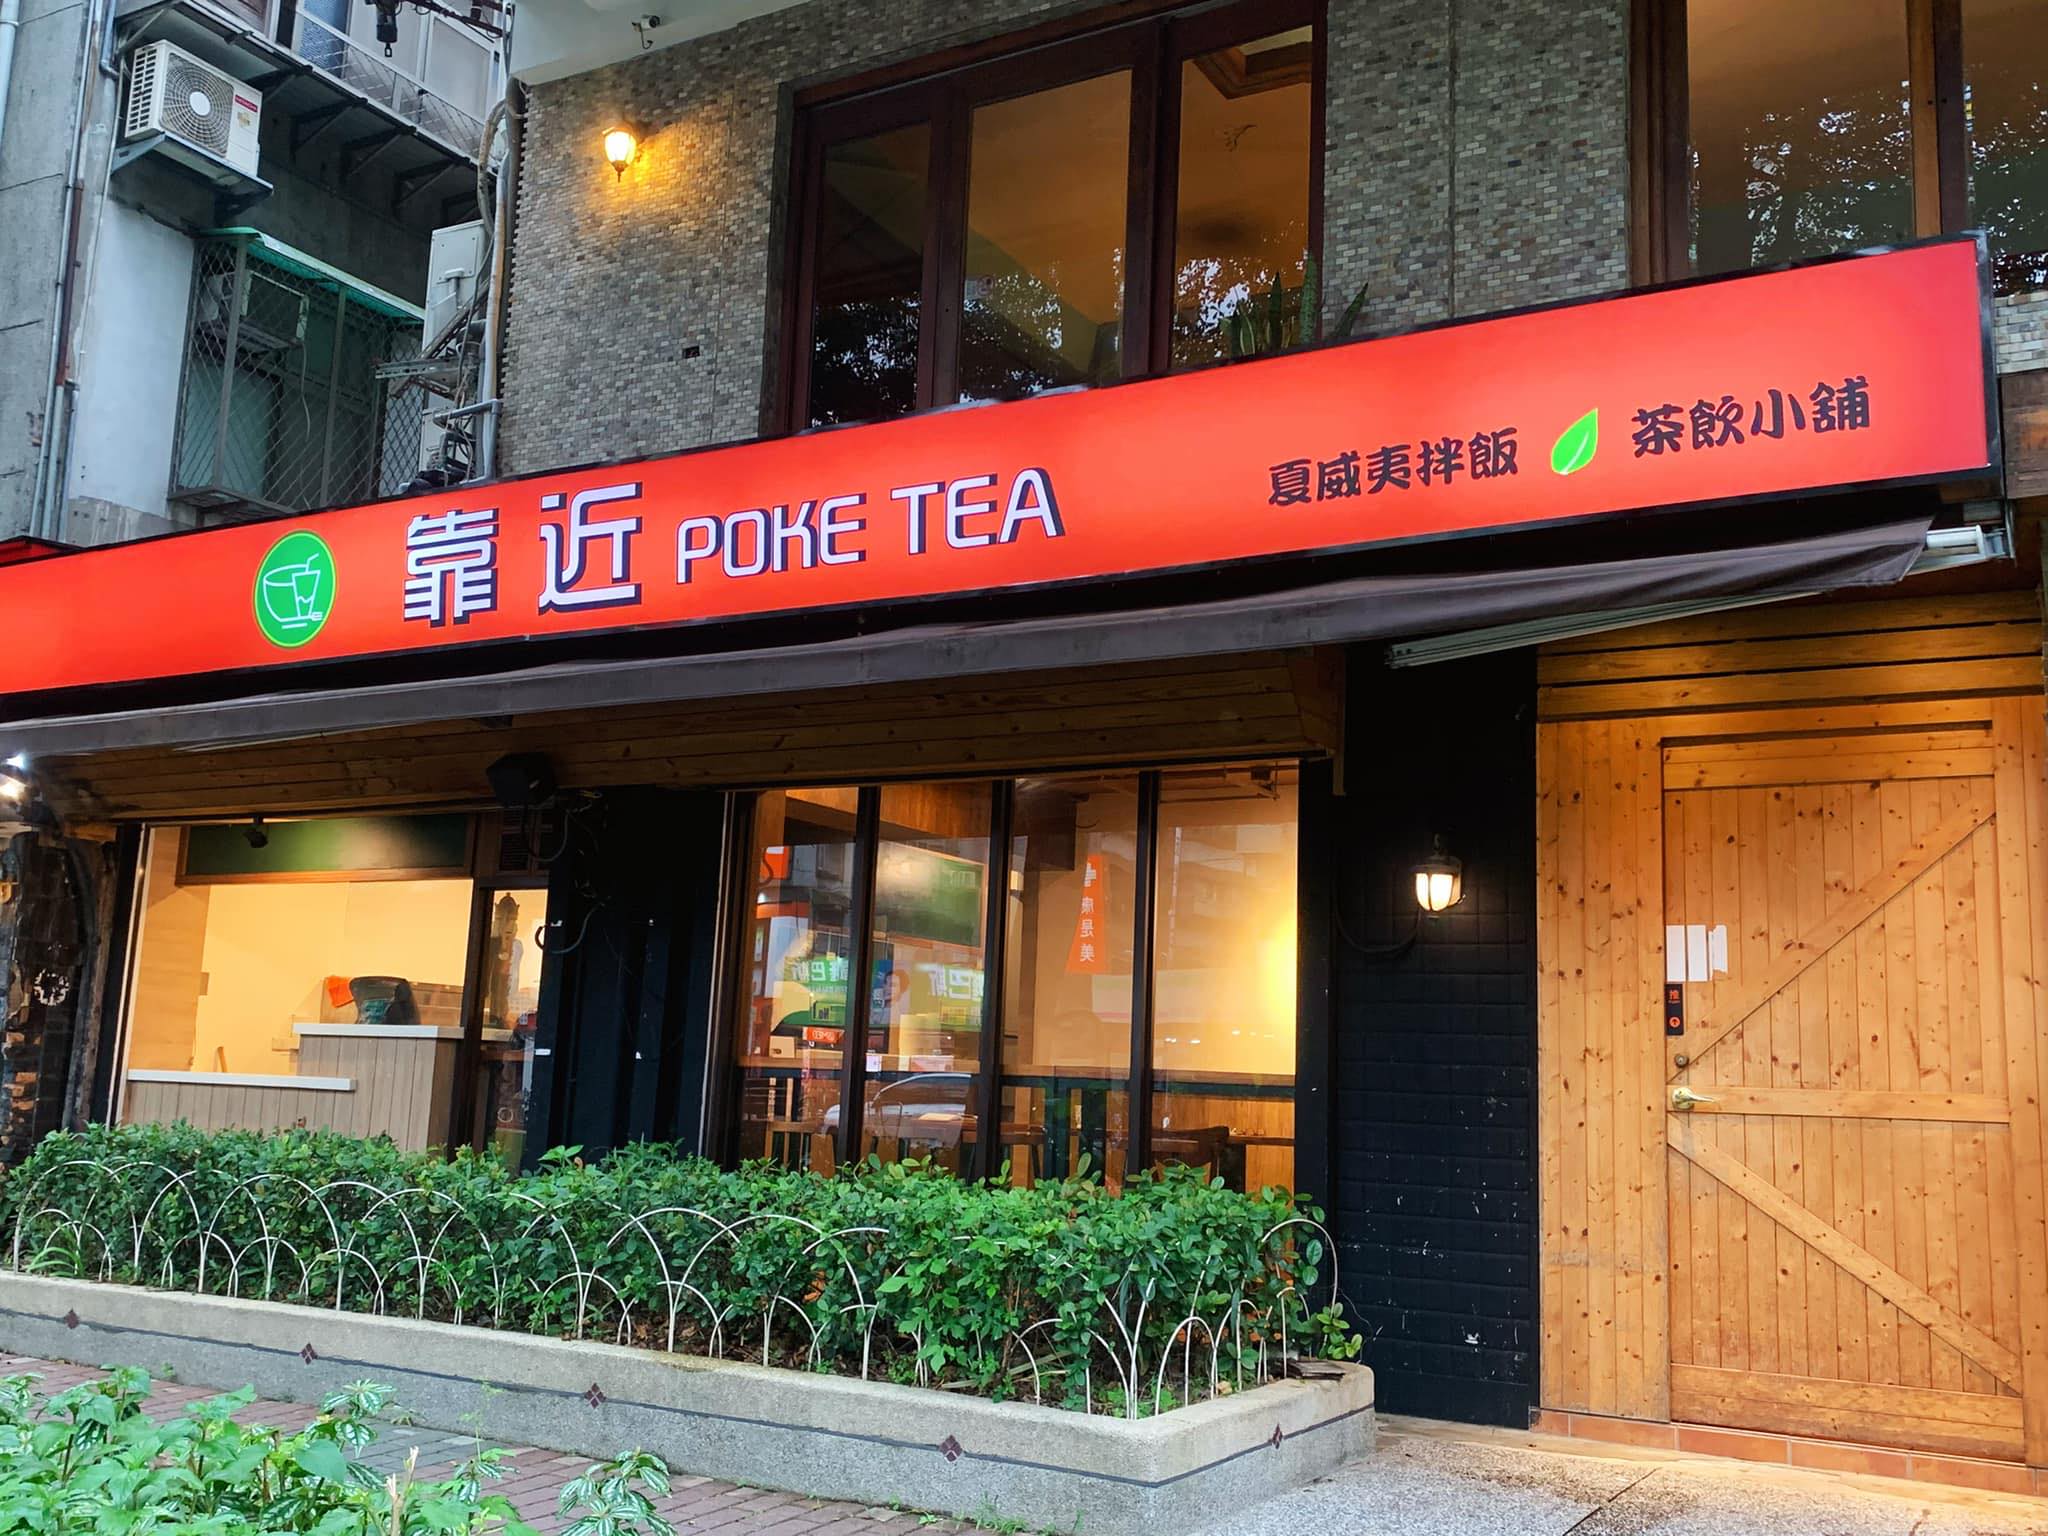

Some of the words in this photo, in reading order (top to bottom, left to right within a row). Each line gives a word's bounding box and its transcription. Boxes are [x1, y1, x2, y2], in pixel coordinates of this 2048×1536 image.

[1632, 376, 1870, 458] 茶飲小舖
[1269, 428, 1518, 506] 夏威夷拌飯
[404, 482, 642, 627] 靠近
[676, 493, 867, 585] POKE
[890, 467, 1066, 555] TEA
